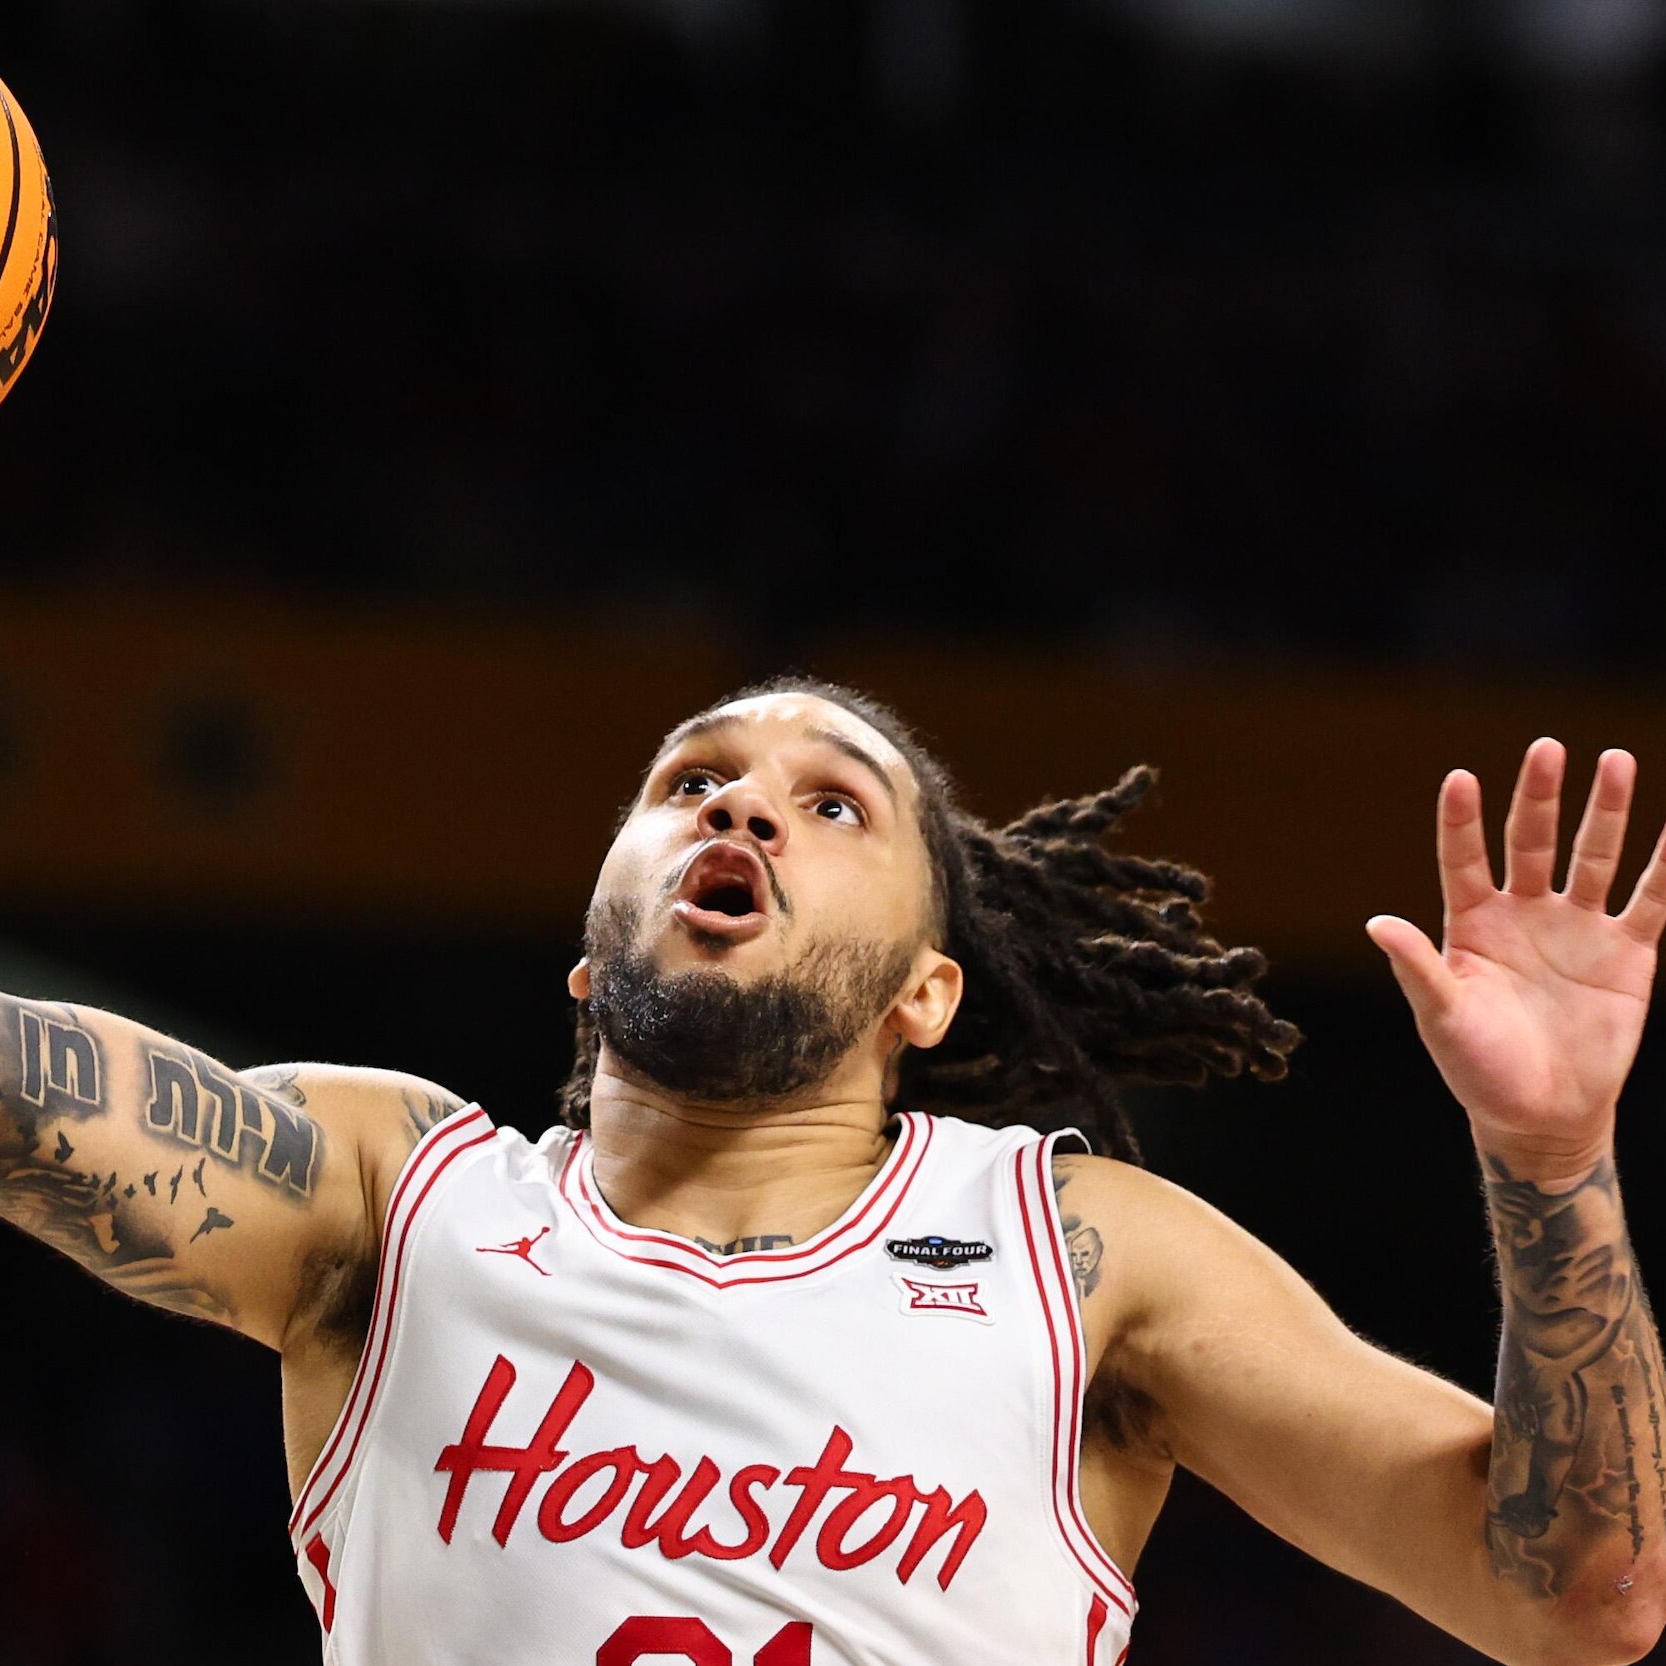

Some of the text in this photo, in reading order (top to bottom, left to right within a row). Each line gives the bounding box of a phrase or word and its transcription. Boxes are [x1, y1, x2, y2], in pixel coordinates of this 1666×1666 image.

[893, 1244, 988, 1256] FINAL FOUR
[433, 1353, 988, 1593] Houston
